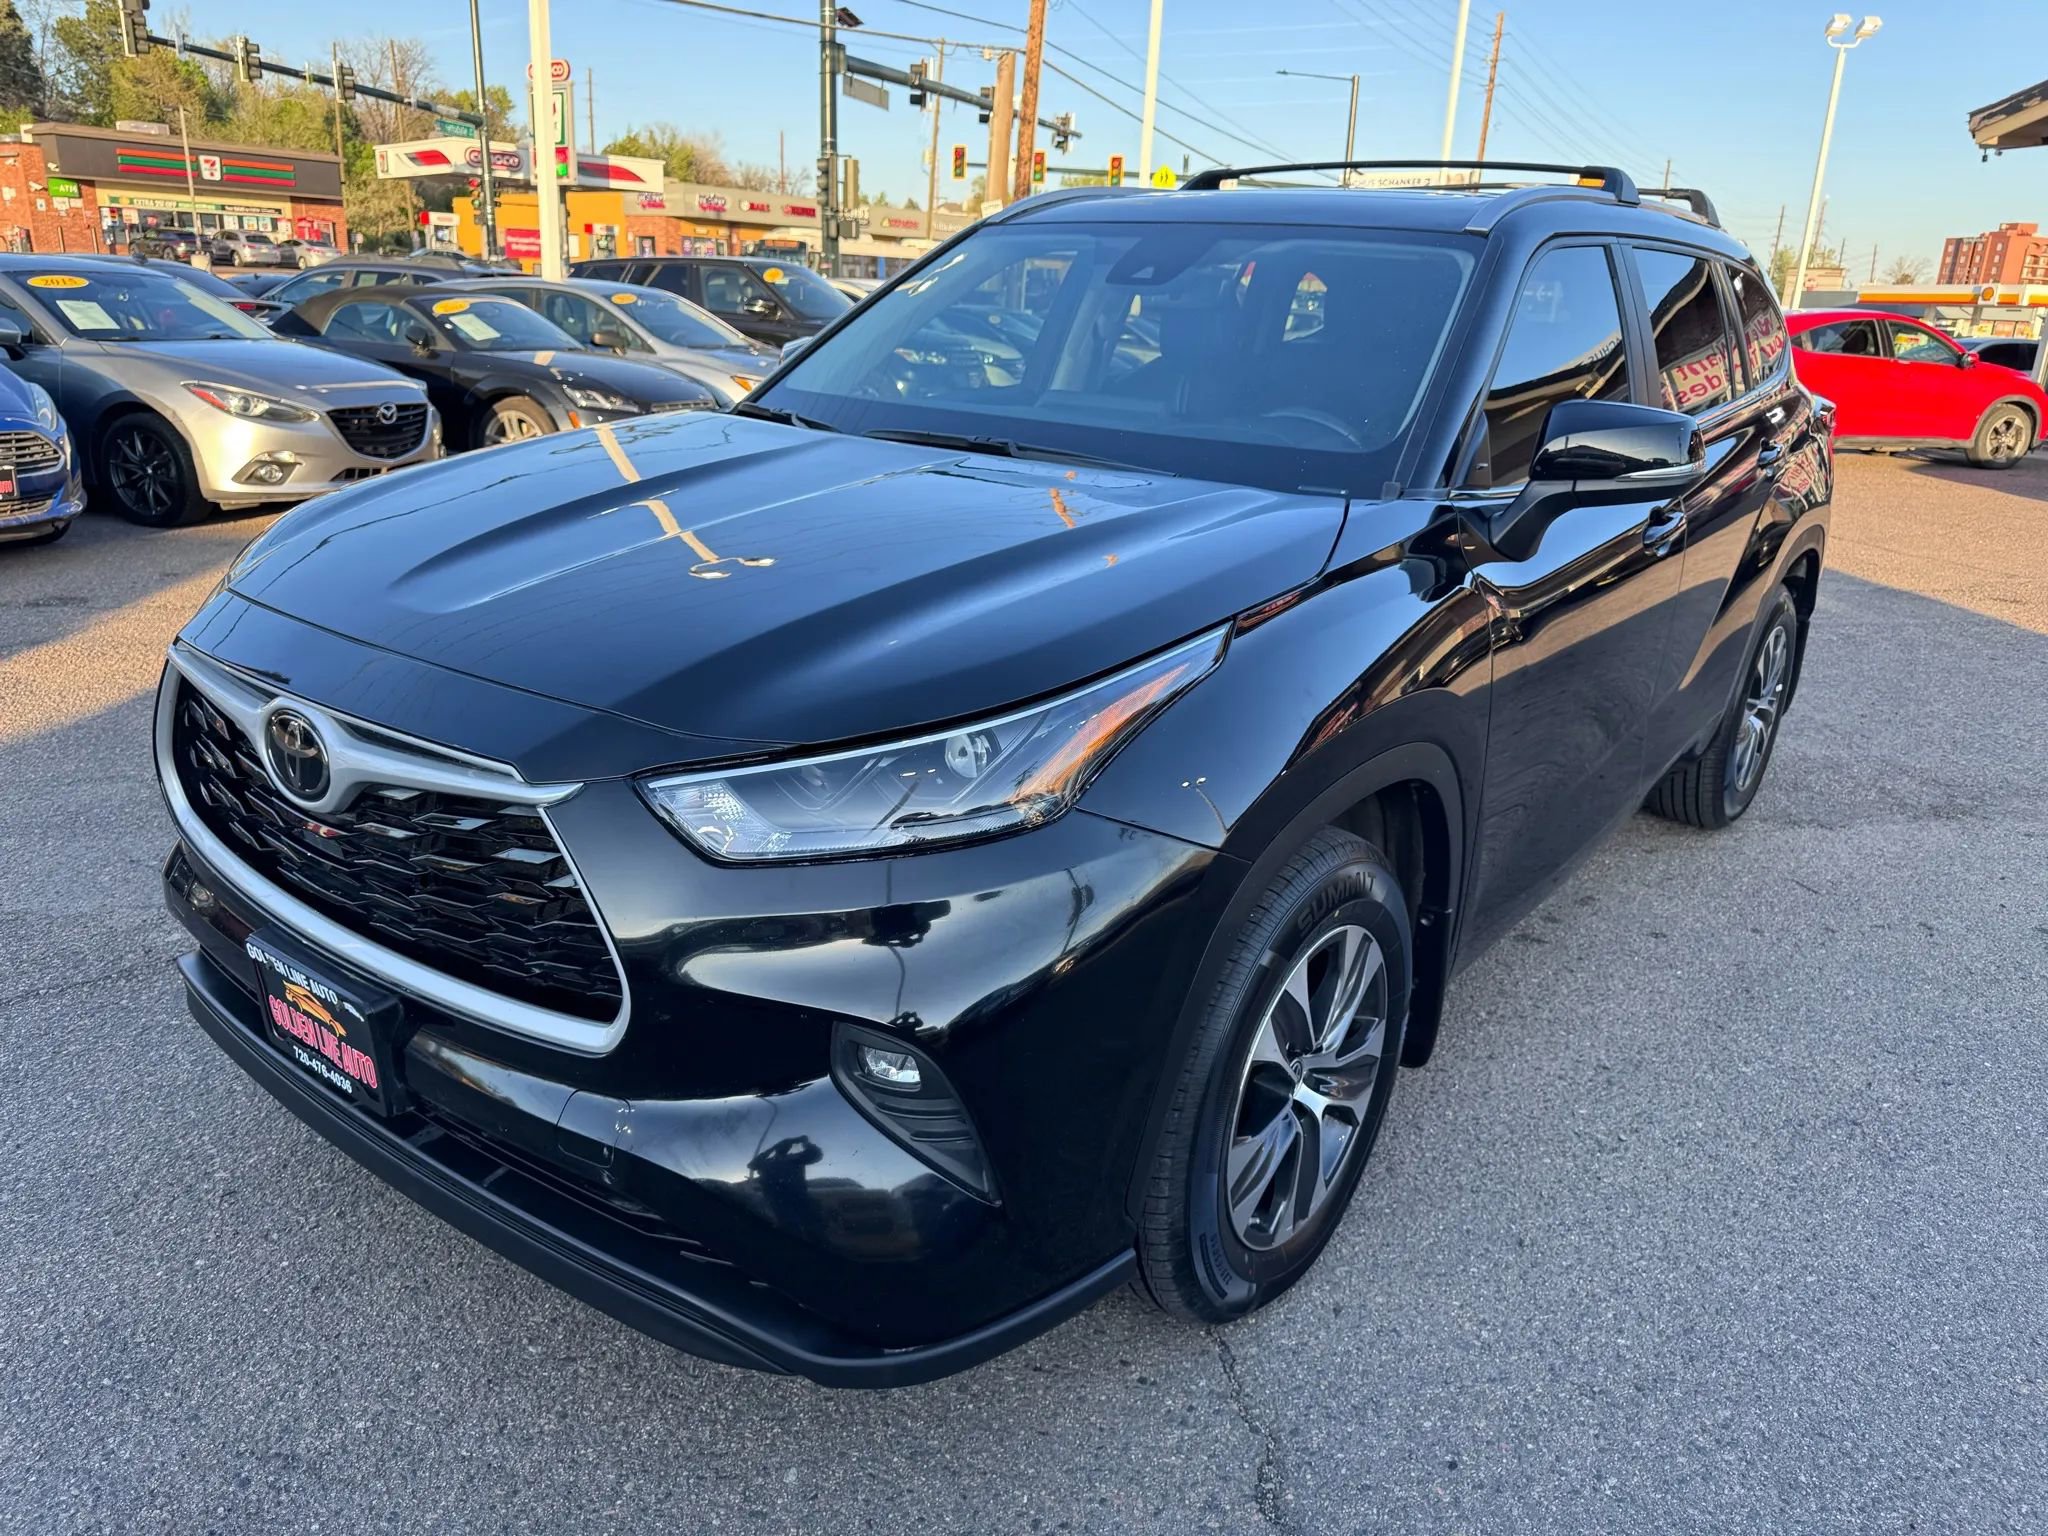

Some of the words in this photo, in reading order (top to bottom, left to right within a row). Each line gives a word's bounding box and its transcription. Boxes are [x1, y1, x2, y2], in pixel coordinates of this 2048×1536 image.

[40, 278, 77, 286] 2015
[1298, 871, 1377, 937] SUMMIT
[284, 964, 308, 989] LINE
[309, 979, 338, 1004] AUTO
[268, 994, 319, 1049] GOLDEN
[314, 1021, 343, 1069] LINE
[341, 1042, 378, 1089] AUTO
